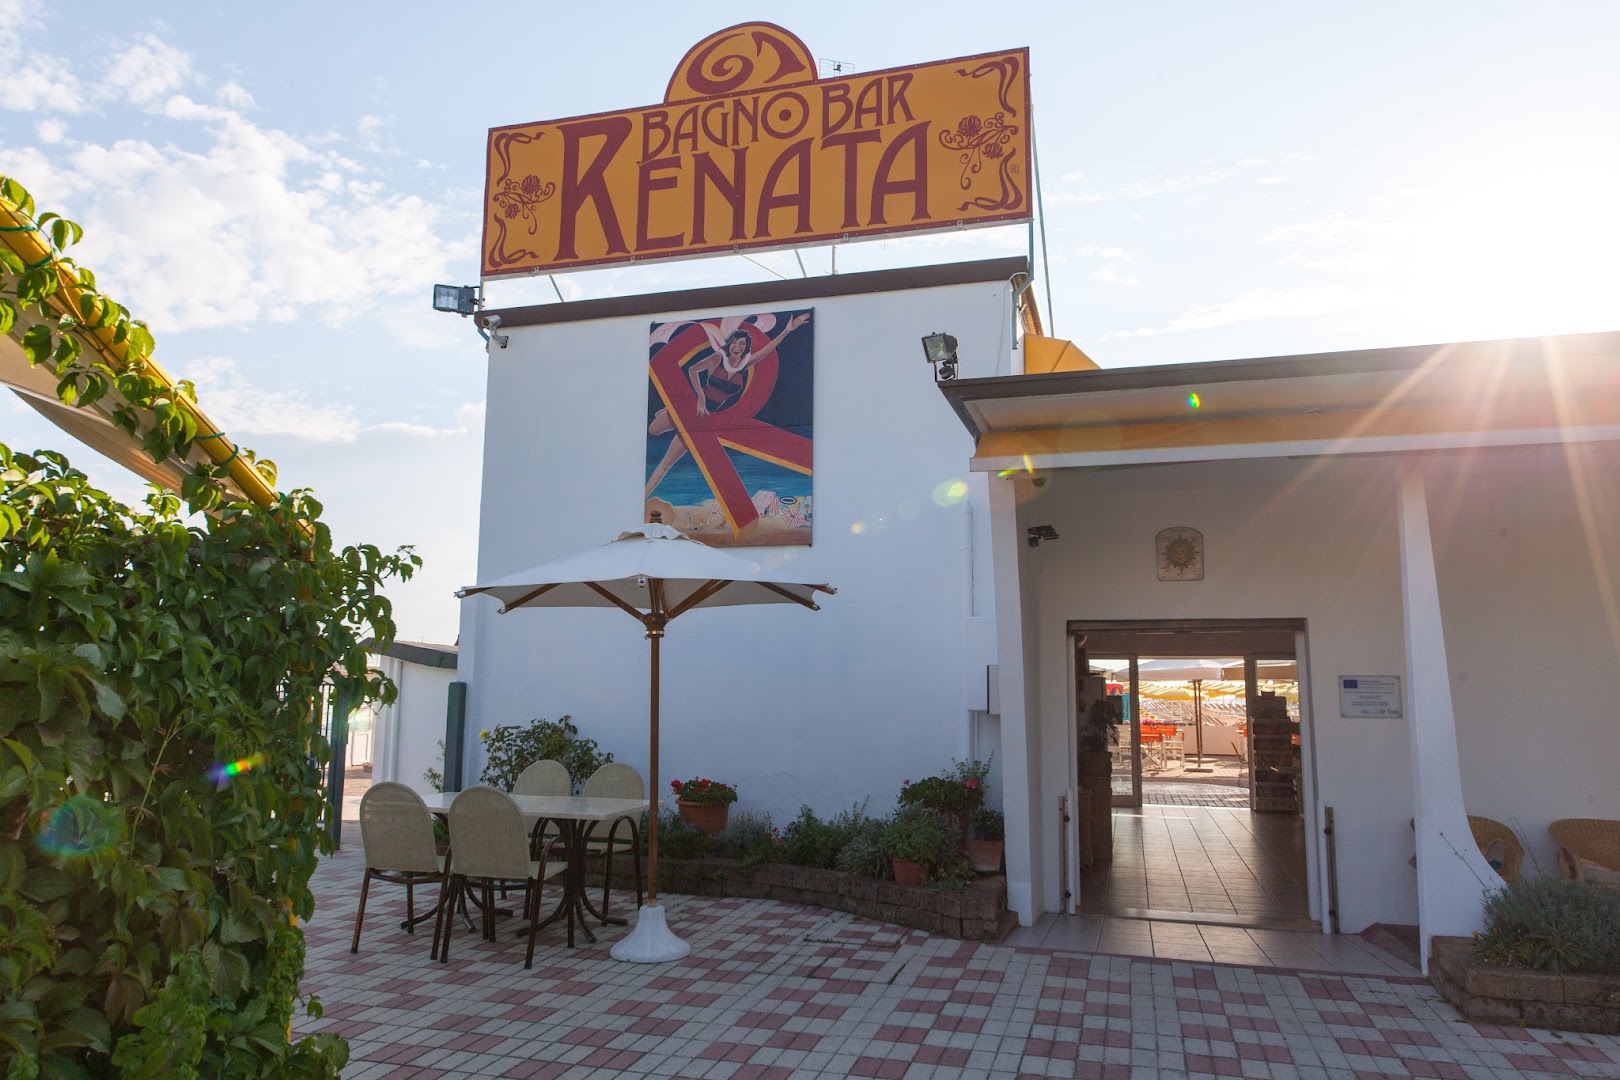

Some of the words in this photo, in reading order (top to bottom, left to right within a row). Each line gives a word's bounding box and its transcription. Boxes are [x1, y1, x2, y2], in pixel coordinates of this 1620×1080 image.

[553, 116, 932, 262] RENATA
[637, 91, 810, 166] BAGNO
[821, 72, 916, 139] BAR
[649, 318, 813, 541] R
